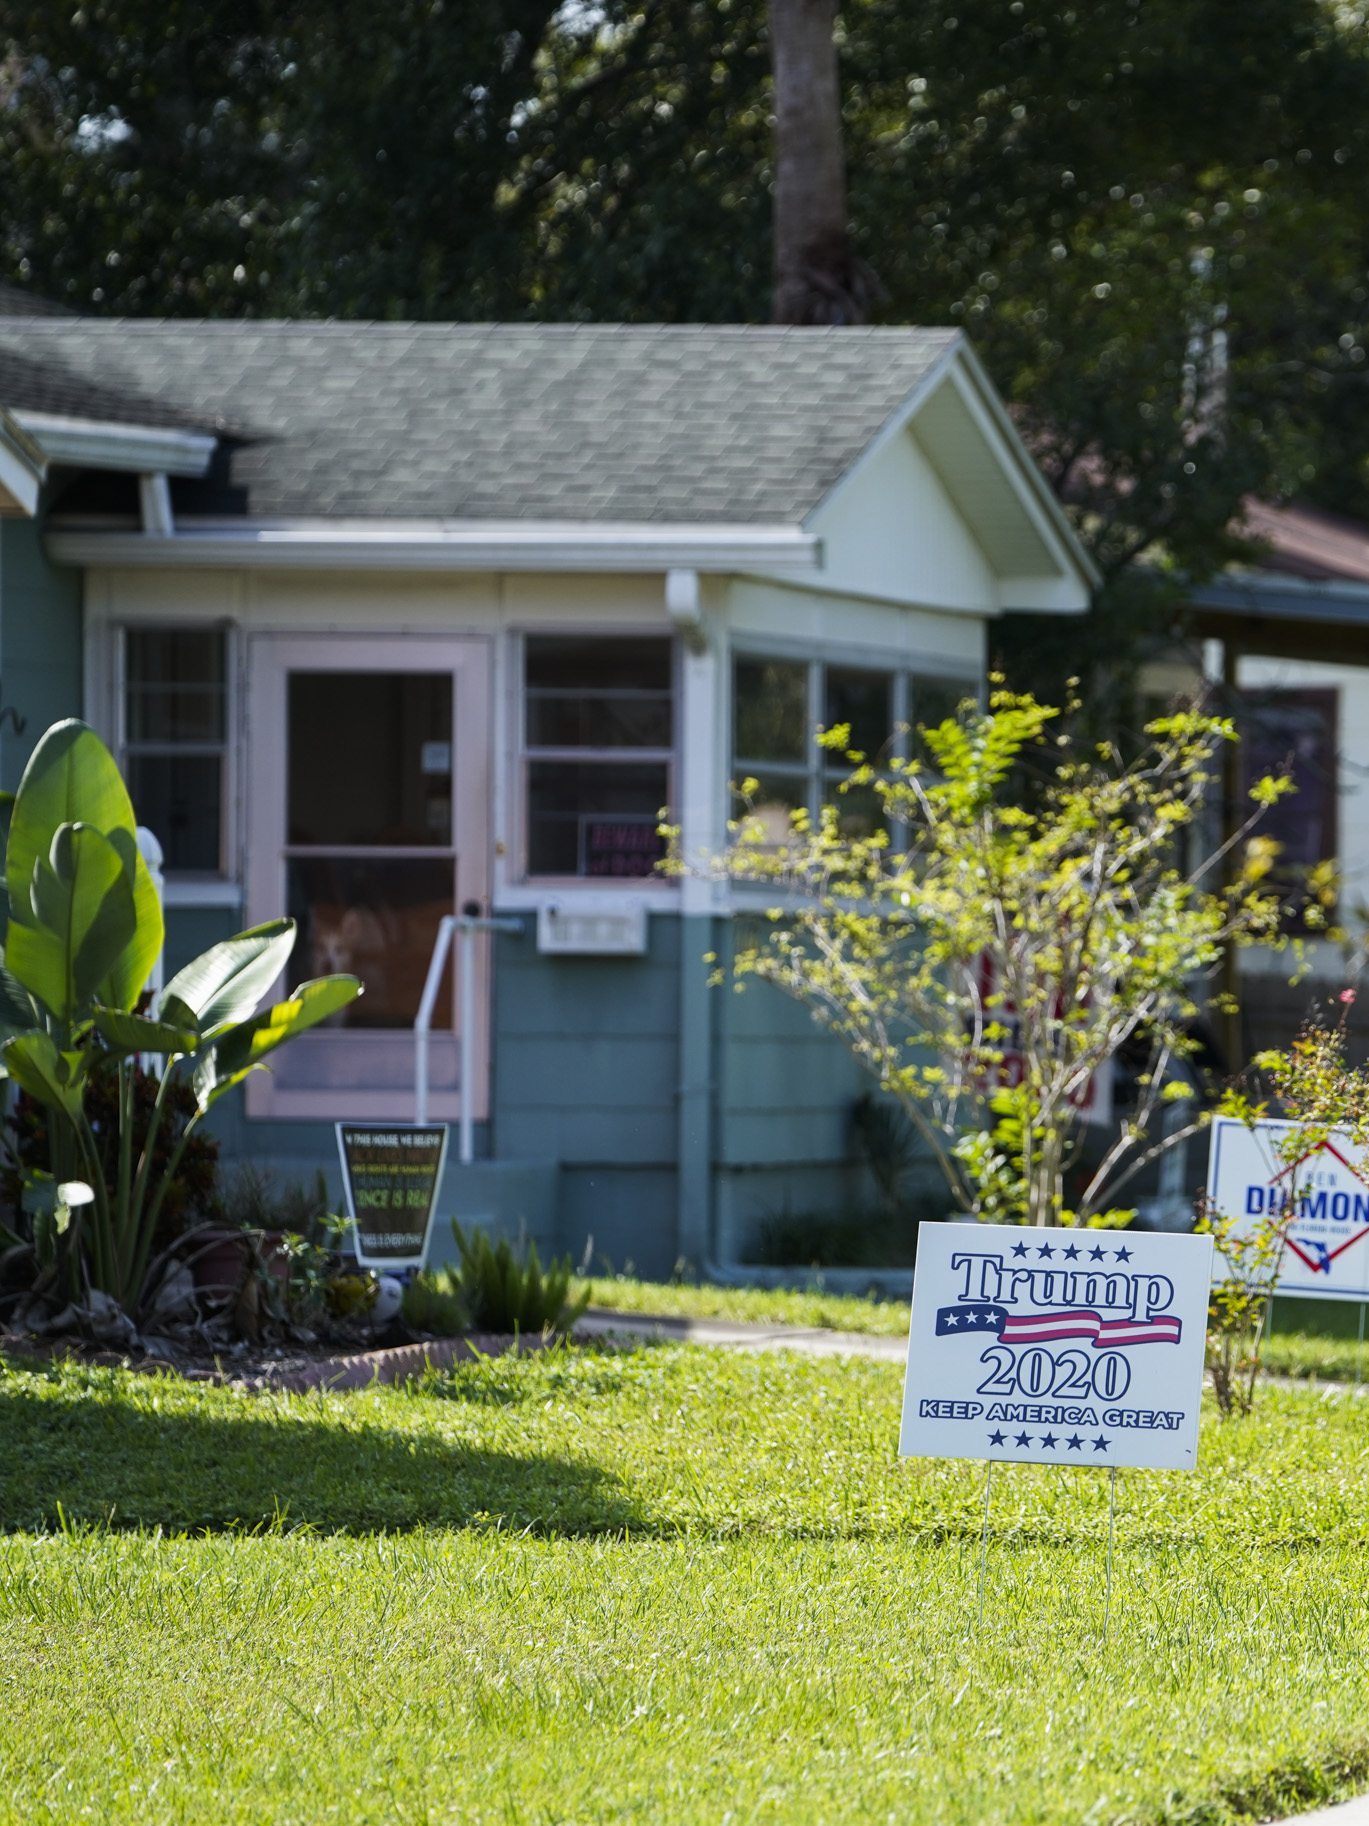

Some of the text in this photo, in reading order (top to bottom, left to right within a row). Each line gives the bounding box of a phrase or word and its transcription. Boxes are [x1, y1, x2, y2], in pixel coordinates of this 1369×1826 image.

[951, 1253, 1174, 1324] Trump
[976, 1345, 1131, 1402] 2020
[919, 1400, 1184, 1430] KEEP AMERICA GREAT
